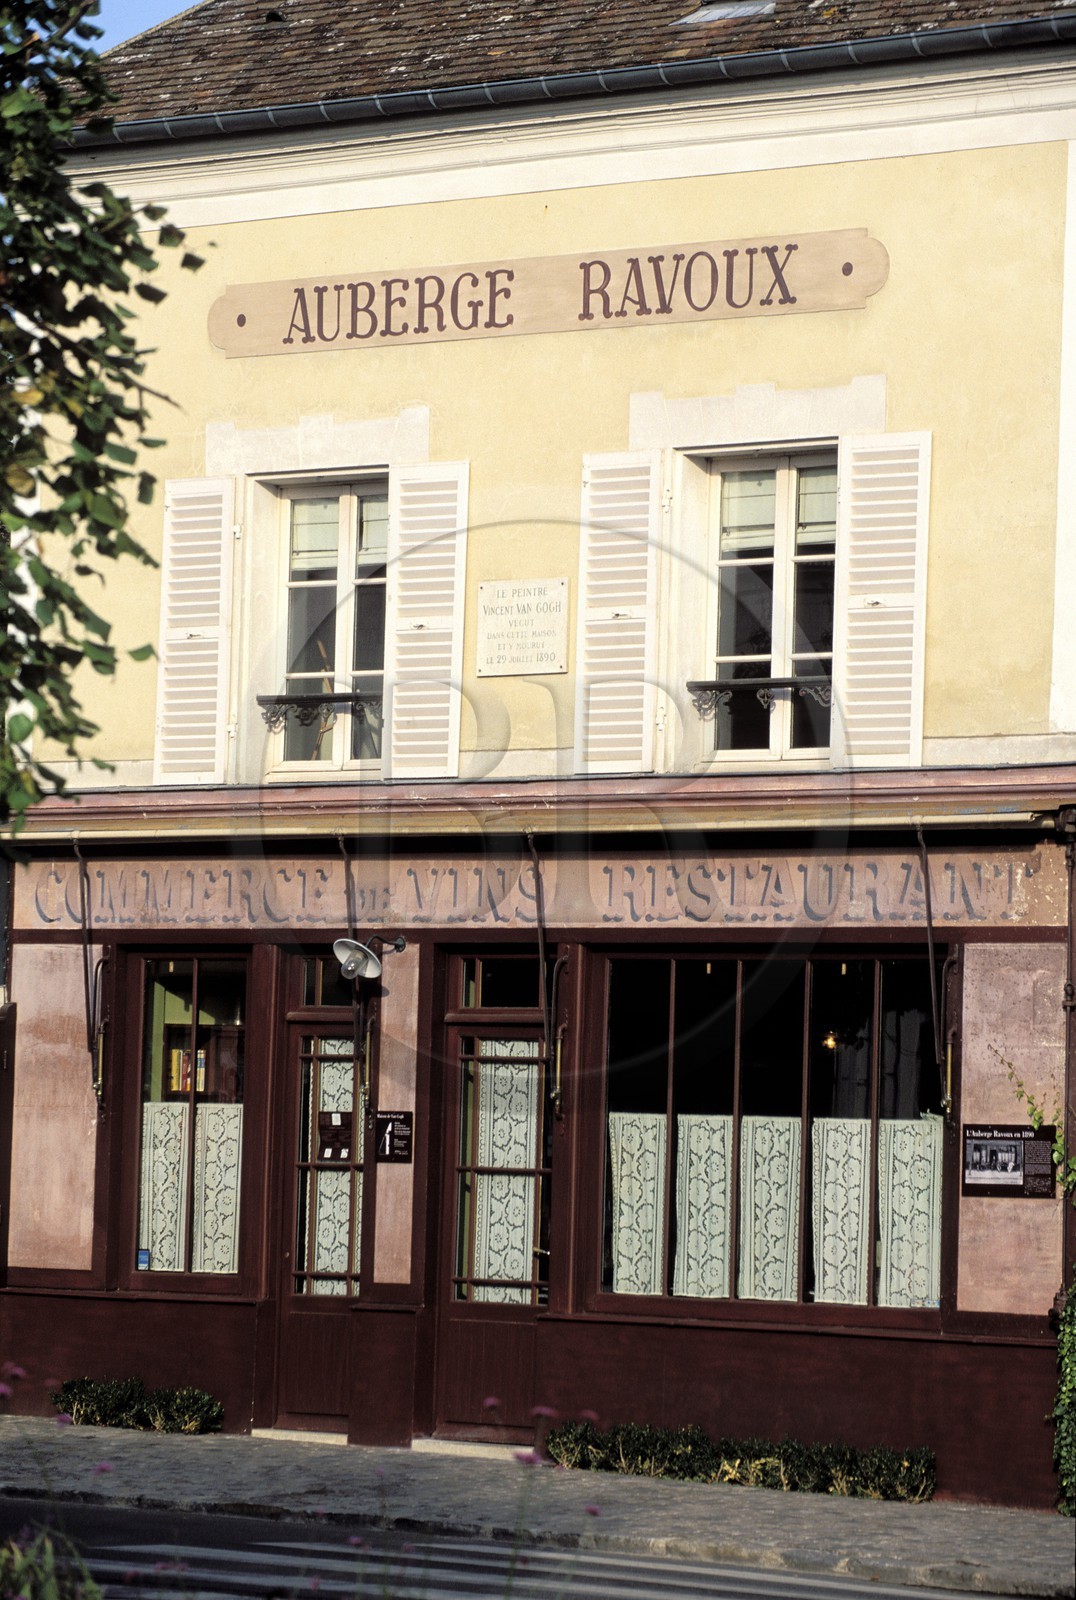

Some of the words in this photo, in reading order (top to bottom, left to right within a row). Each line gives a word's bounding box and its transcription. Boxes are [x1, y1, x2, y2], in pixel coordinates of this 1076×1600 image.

[282, 268, 515, 345] AUBERGE
[578, 243, 799, 322] RAVOUX
[496, 589, 507, 599] LE
[511, 587, 549, 598] PEINTRE
[482, 604, 514, 617] VINCENT
[516, 602, 533, 615] VAN
[535, 601, 562, 614] GOGH
[531, 629, 557, 639] MAISON
[485, 657, 495, 665] LE
[496, 654, 507, 664] 29
[536, 652, 557, 663] 1890
[34, 861, 334, 923] COMMERCE
[404, 861, 546, 923] VINS
[600, 854, 1042, 922] RESTAURANT
[966, 1130, 992, 1139] L'Auberge
[993, 1130, 1014, 1138] Ravoux
[1021, 1130, 1034, 1138] 1890
